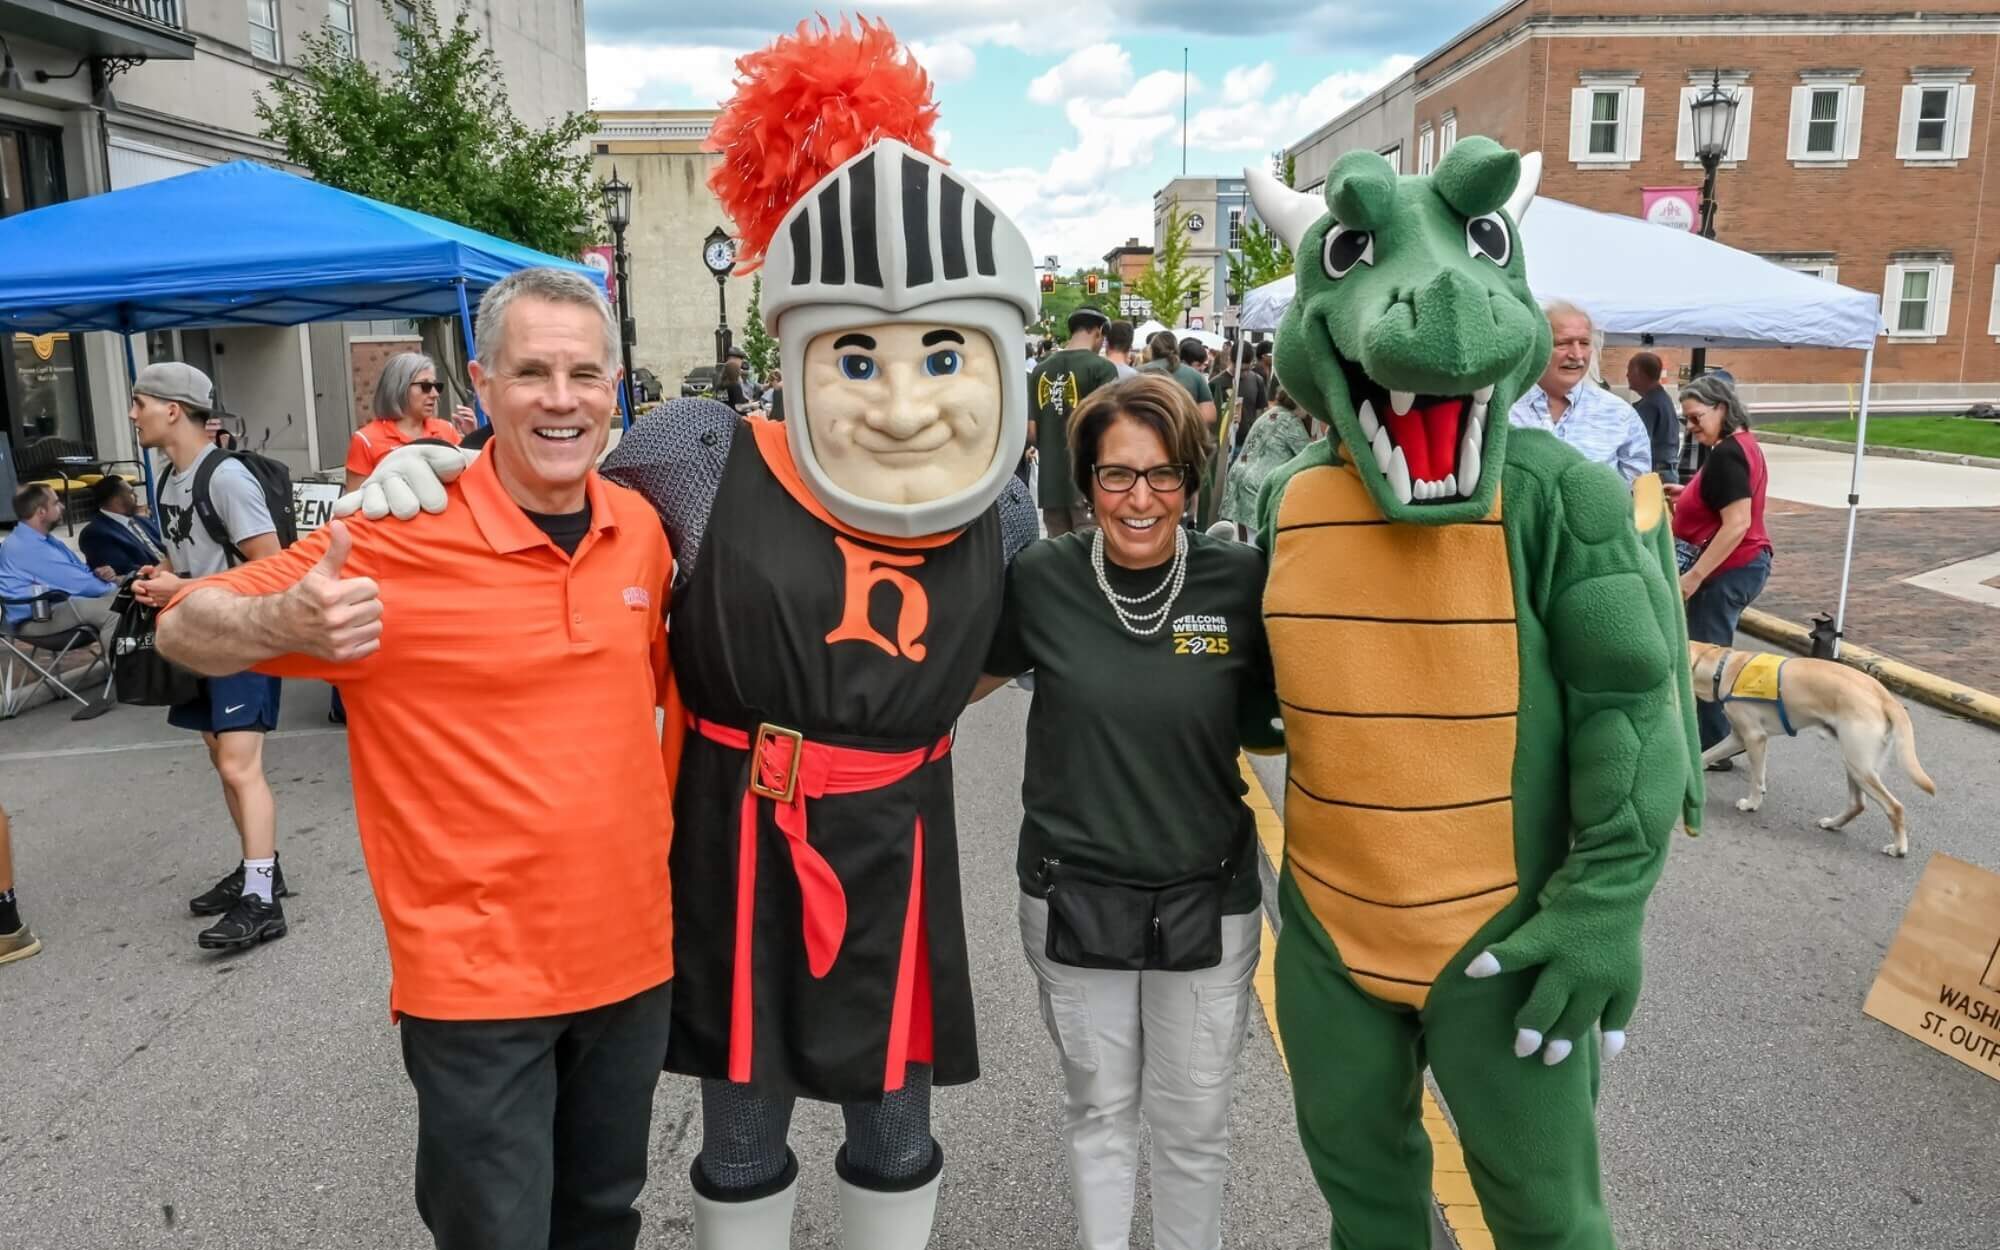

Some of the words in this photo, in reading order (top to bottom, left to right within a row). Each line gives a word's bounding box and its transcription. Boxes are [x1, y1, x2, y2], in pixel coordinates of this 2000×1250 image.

[1172, 623, 1228, 633] WEEKEND
[1173, 614, 1226, 625] WELCOME
[1939, 984, 2000, 1032] WASHI
[1920, 1011, 1947, 1038] ST.
[1950, 1025, 2000, 1066] OUTF
